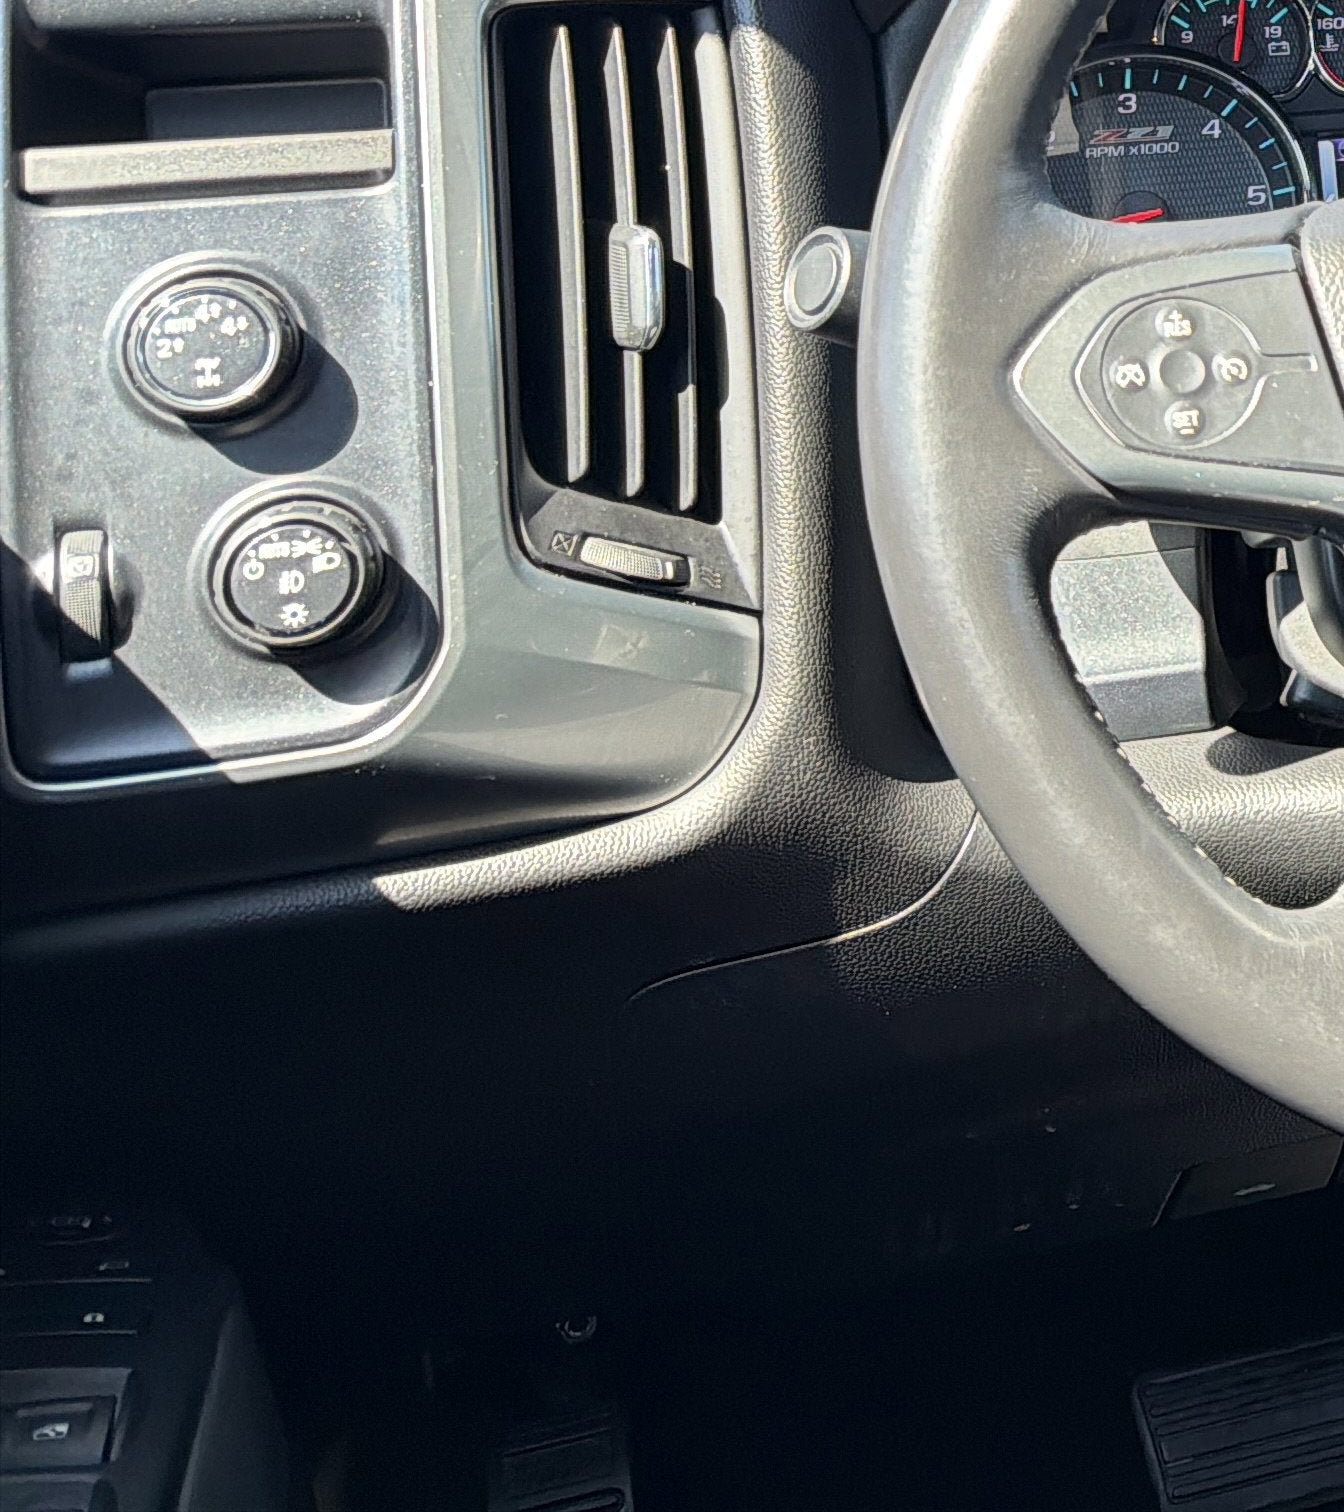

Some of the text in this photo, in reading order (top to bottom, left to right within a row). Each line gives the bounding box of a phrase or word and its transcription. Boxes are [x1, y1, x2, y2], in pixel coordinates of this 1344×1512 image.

[1264, 25, 1282, 38] 19
[1317, 17, 1344, 30] 160
[1181, 31, 1194, 44] 9
[1117, 93, 1137, 114] 3
[1201, 119, 1222, 138] 4
[1086, 142, 1180, 159] RPM x1000
[1246, 186, 1267, 206] 5
